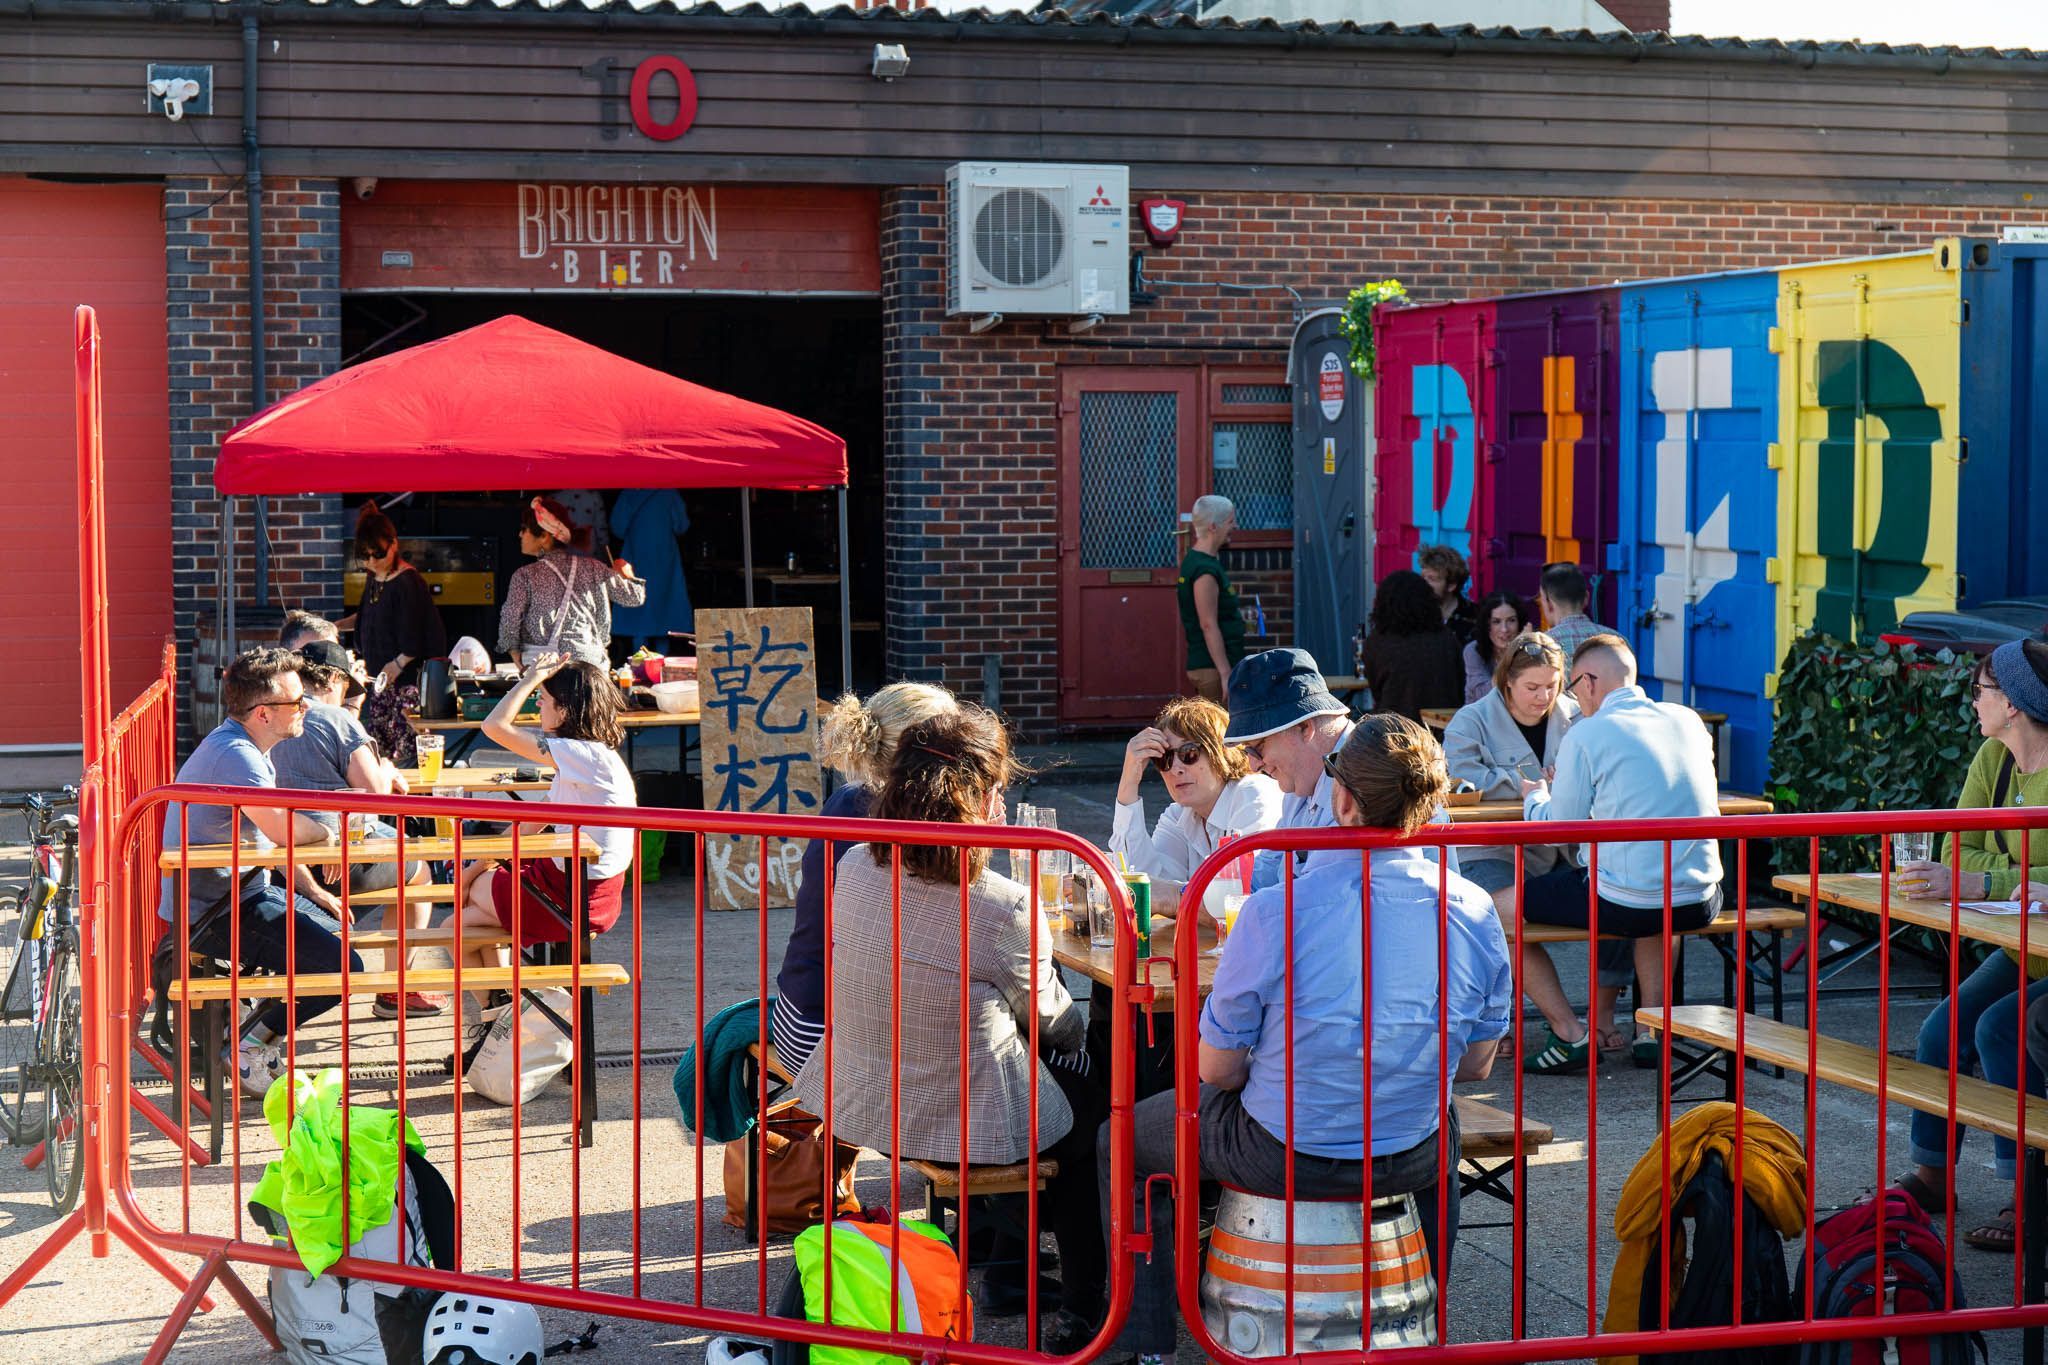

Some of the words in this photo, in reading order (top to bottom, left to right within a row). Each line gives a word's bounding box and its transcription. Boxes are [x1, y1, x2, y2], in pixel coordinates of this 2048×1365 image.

[518, 183, 718, 261] BRIGHTON
[563, 250, 674, 284] BIER
[705, 625, 817, 842] 乾杯
